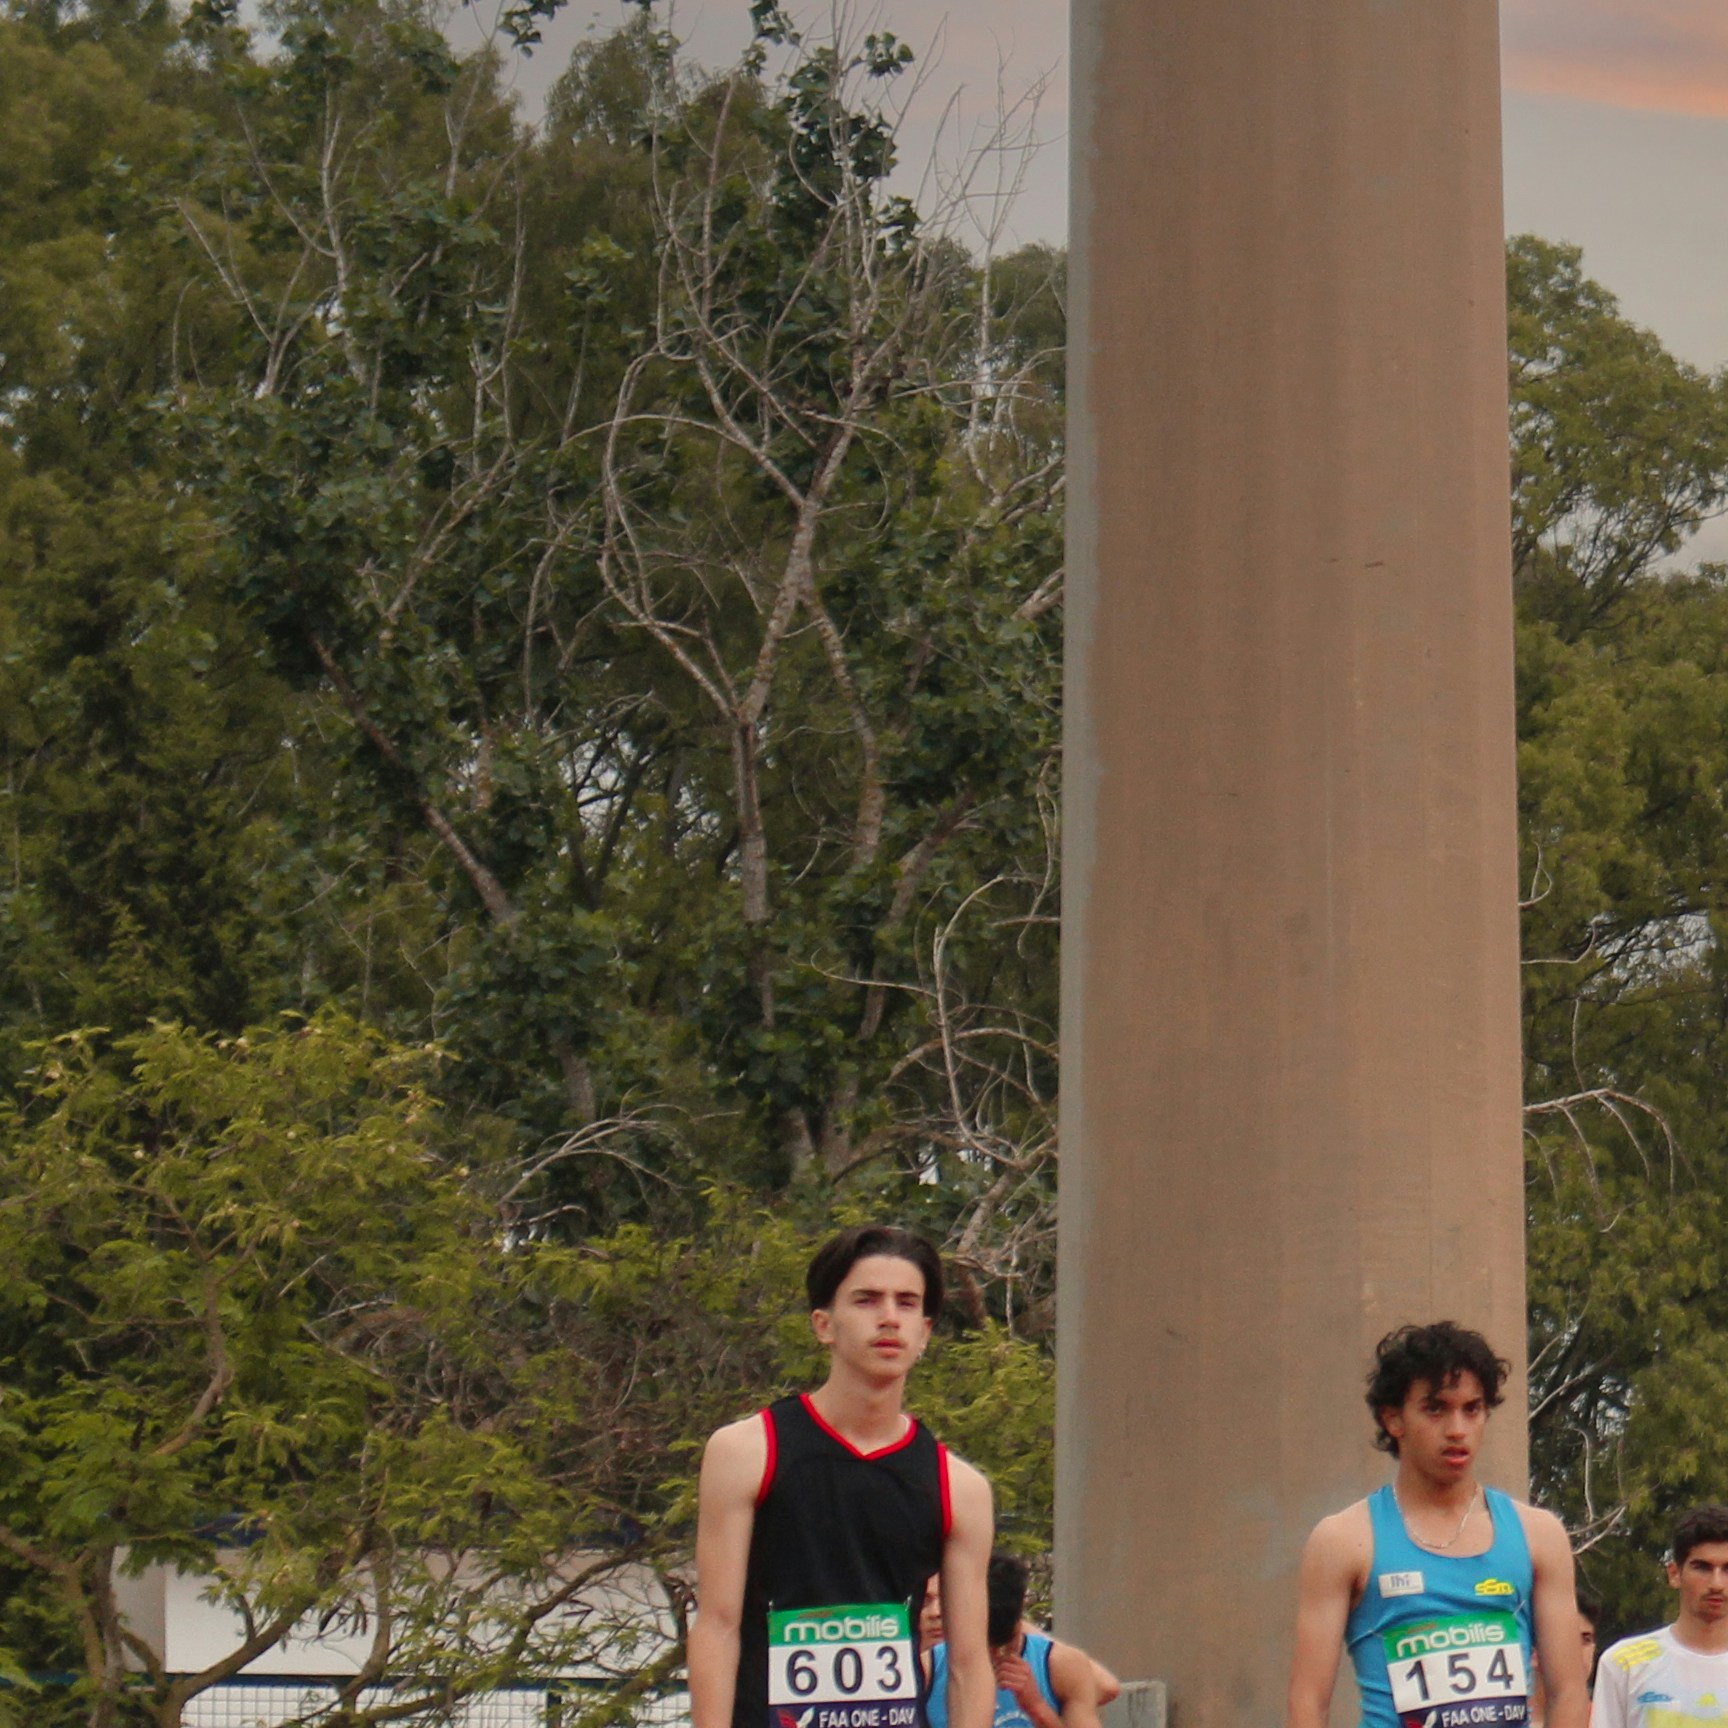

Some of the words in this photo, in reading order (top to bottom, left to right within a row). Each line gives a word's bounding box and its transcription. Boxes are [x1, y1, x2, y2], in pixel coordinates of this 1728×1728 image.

[783, 1614, 899, 1642] mobilis
[1396, 1623, 1505, 1658] mobilis
[786, 1645, 902, 1697] 603
[1405, 1649, 1514, 1701] 154
[819, 1711, 849, 1728] FAA
[851, 1708, 880, 1728] ONE
[1442, 1712, 1469, 1728] FAA
[1470, 1706, 1497, 1723] ONE
